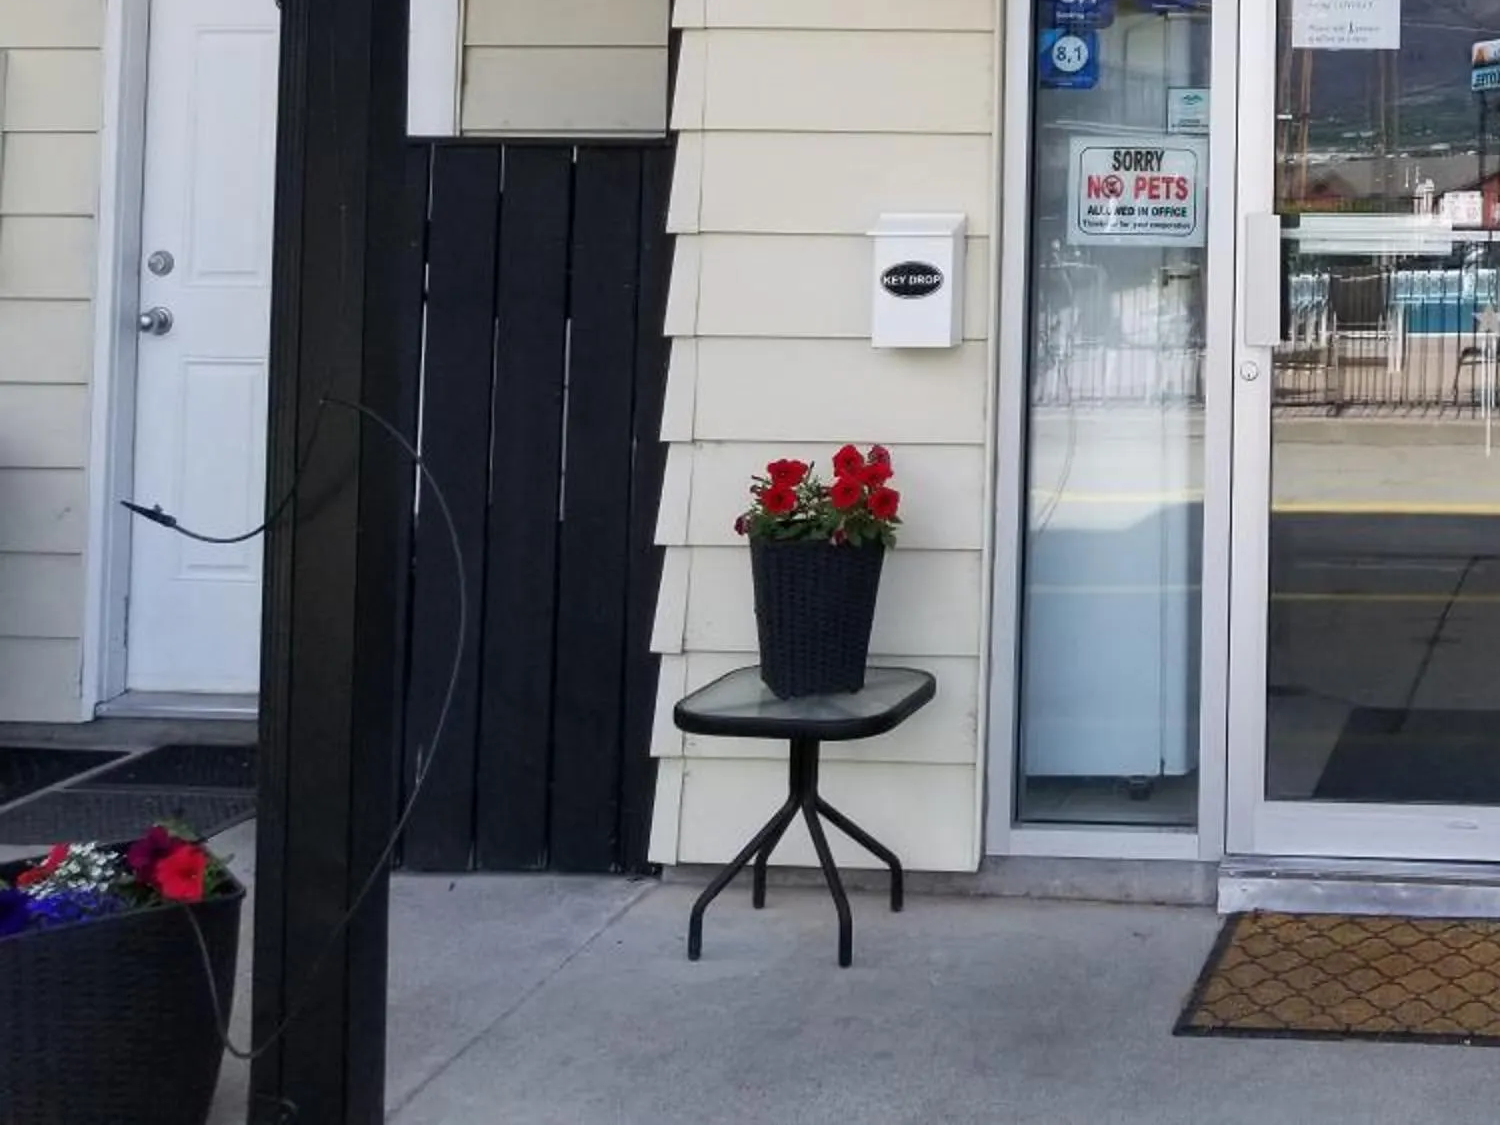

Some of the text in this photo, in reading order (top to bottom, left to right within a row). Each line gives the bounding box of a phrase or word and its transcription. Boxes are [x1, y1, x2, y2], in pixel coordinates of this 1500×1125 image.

[1112, 150, 1165, 172] SORRY
[1087, 174, 1189, 201] NO PETS
[1137, 206, 1149, 216] IN
[1151, 206, 1188, 217] OFFICE
[883, 274, 941, 285] KEY DROP
